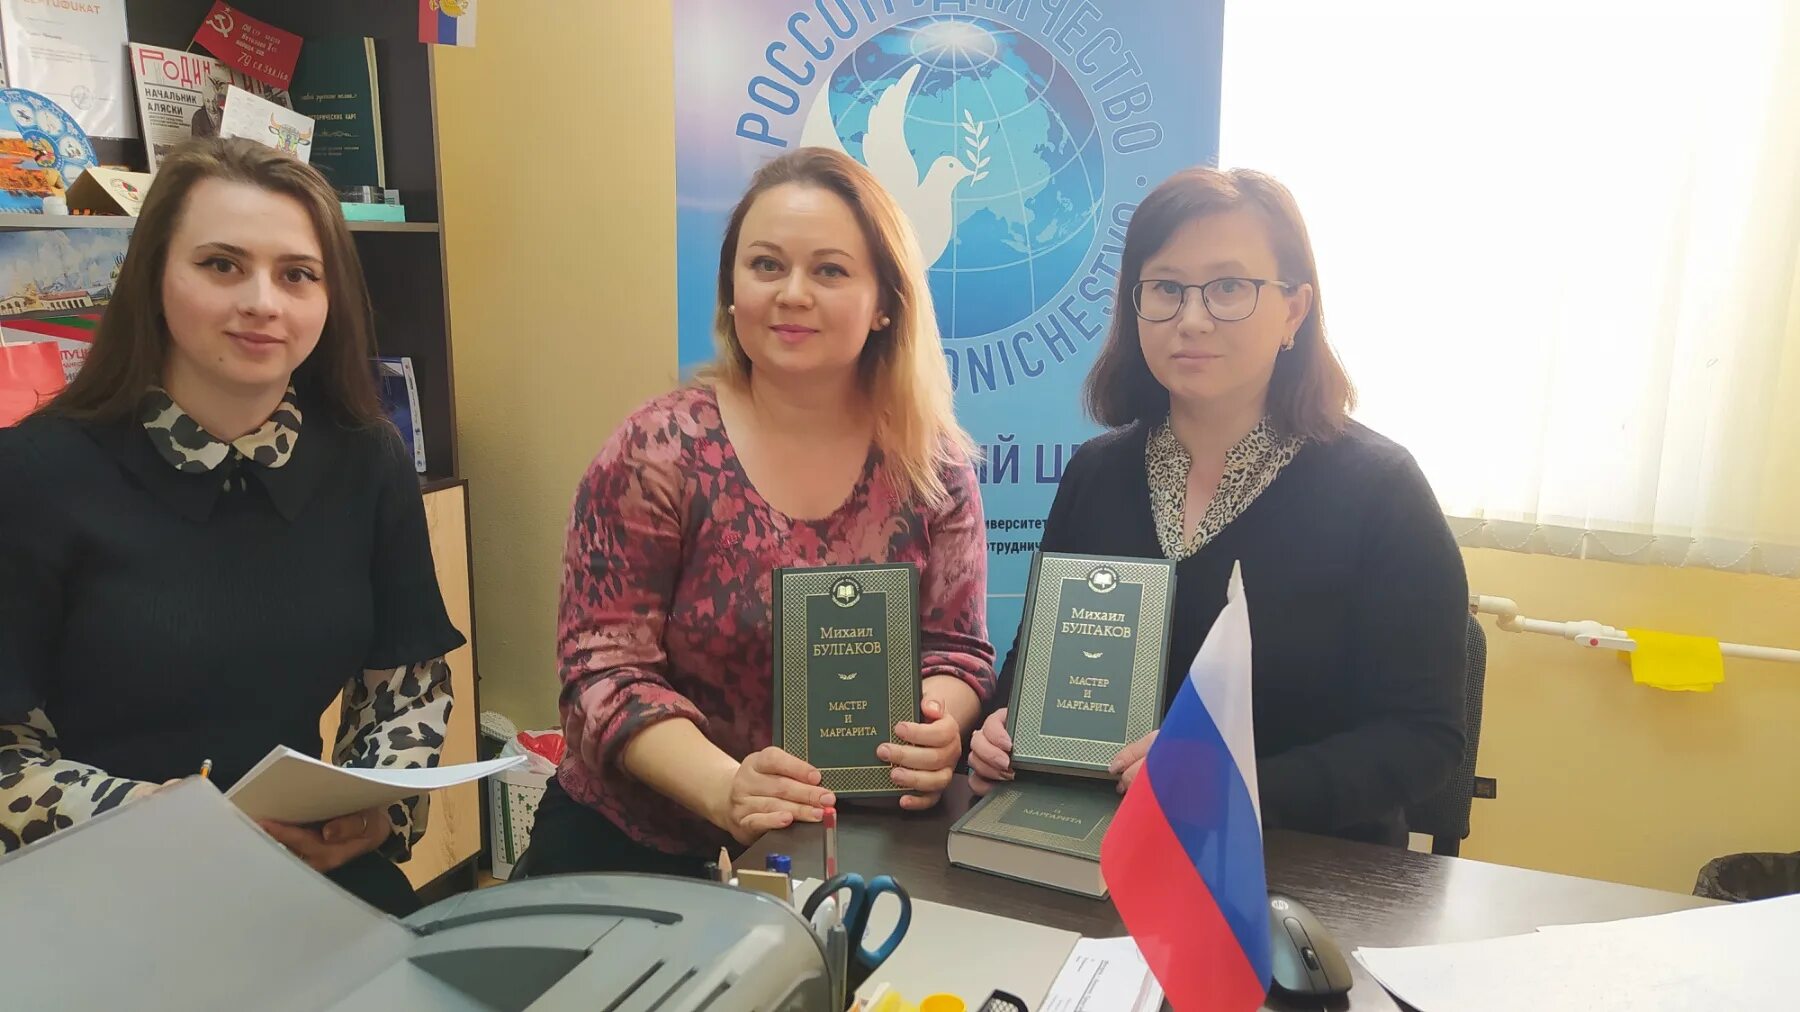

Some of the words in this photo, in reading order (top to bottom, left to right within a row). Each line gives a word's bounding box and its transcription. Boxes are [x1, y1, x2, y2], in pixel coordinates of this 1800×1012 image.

[735, 0, 1164, 154] РОССОЧЕСТВО
[144, 88, 198, 104] НАЧАЛЬНИК
[147, 103, 184, 115] АЛЯСКИ
[1071, 608, 1125, 623] Михаил
[820, 627, 873, 640] Михаил
[1061, 622, 1132, 638] БУЛГАКОВ
[812, 642, 882, 657] БУЛГАКОВ
[1069, 675, 1110, 688] МАСТЕР
[1083, 689, 1092, 699] И
[828, 700, 868, 711] МАСТЕР
[1056, 699, 1116, 714] МАРГАРИТА
[843, 714, 853, 724] И
[820, 726, 878, 738] МАРГАРИТА
